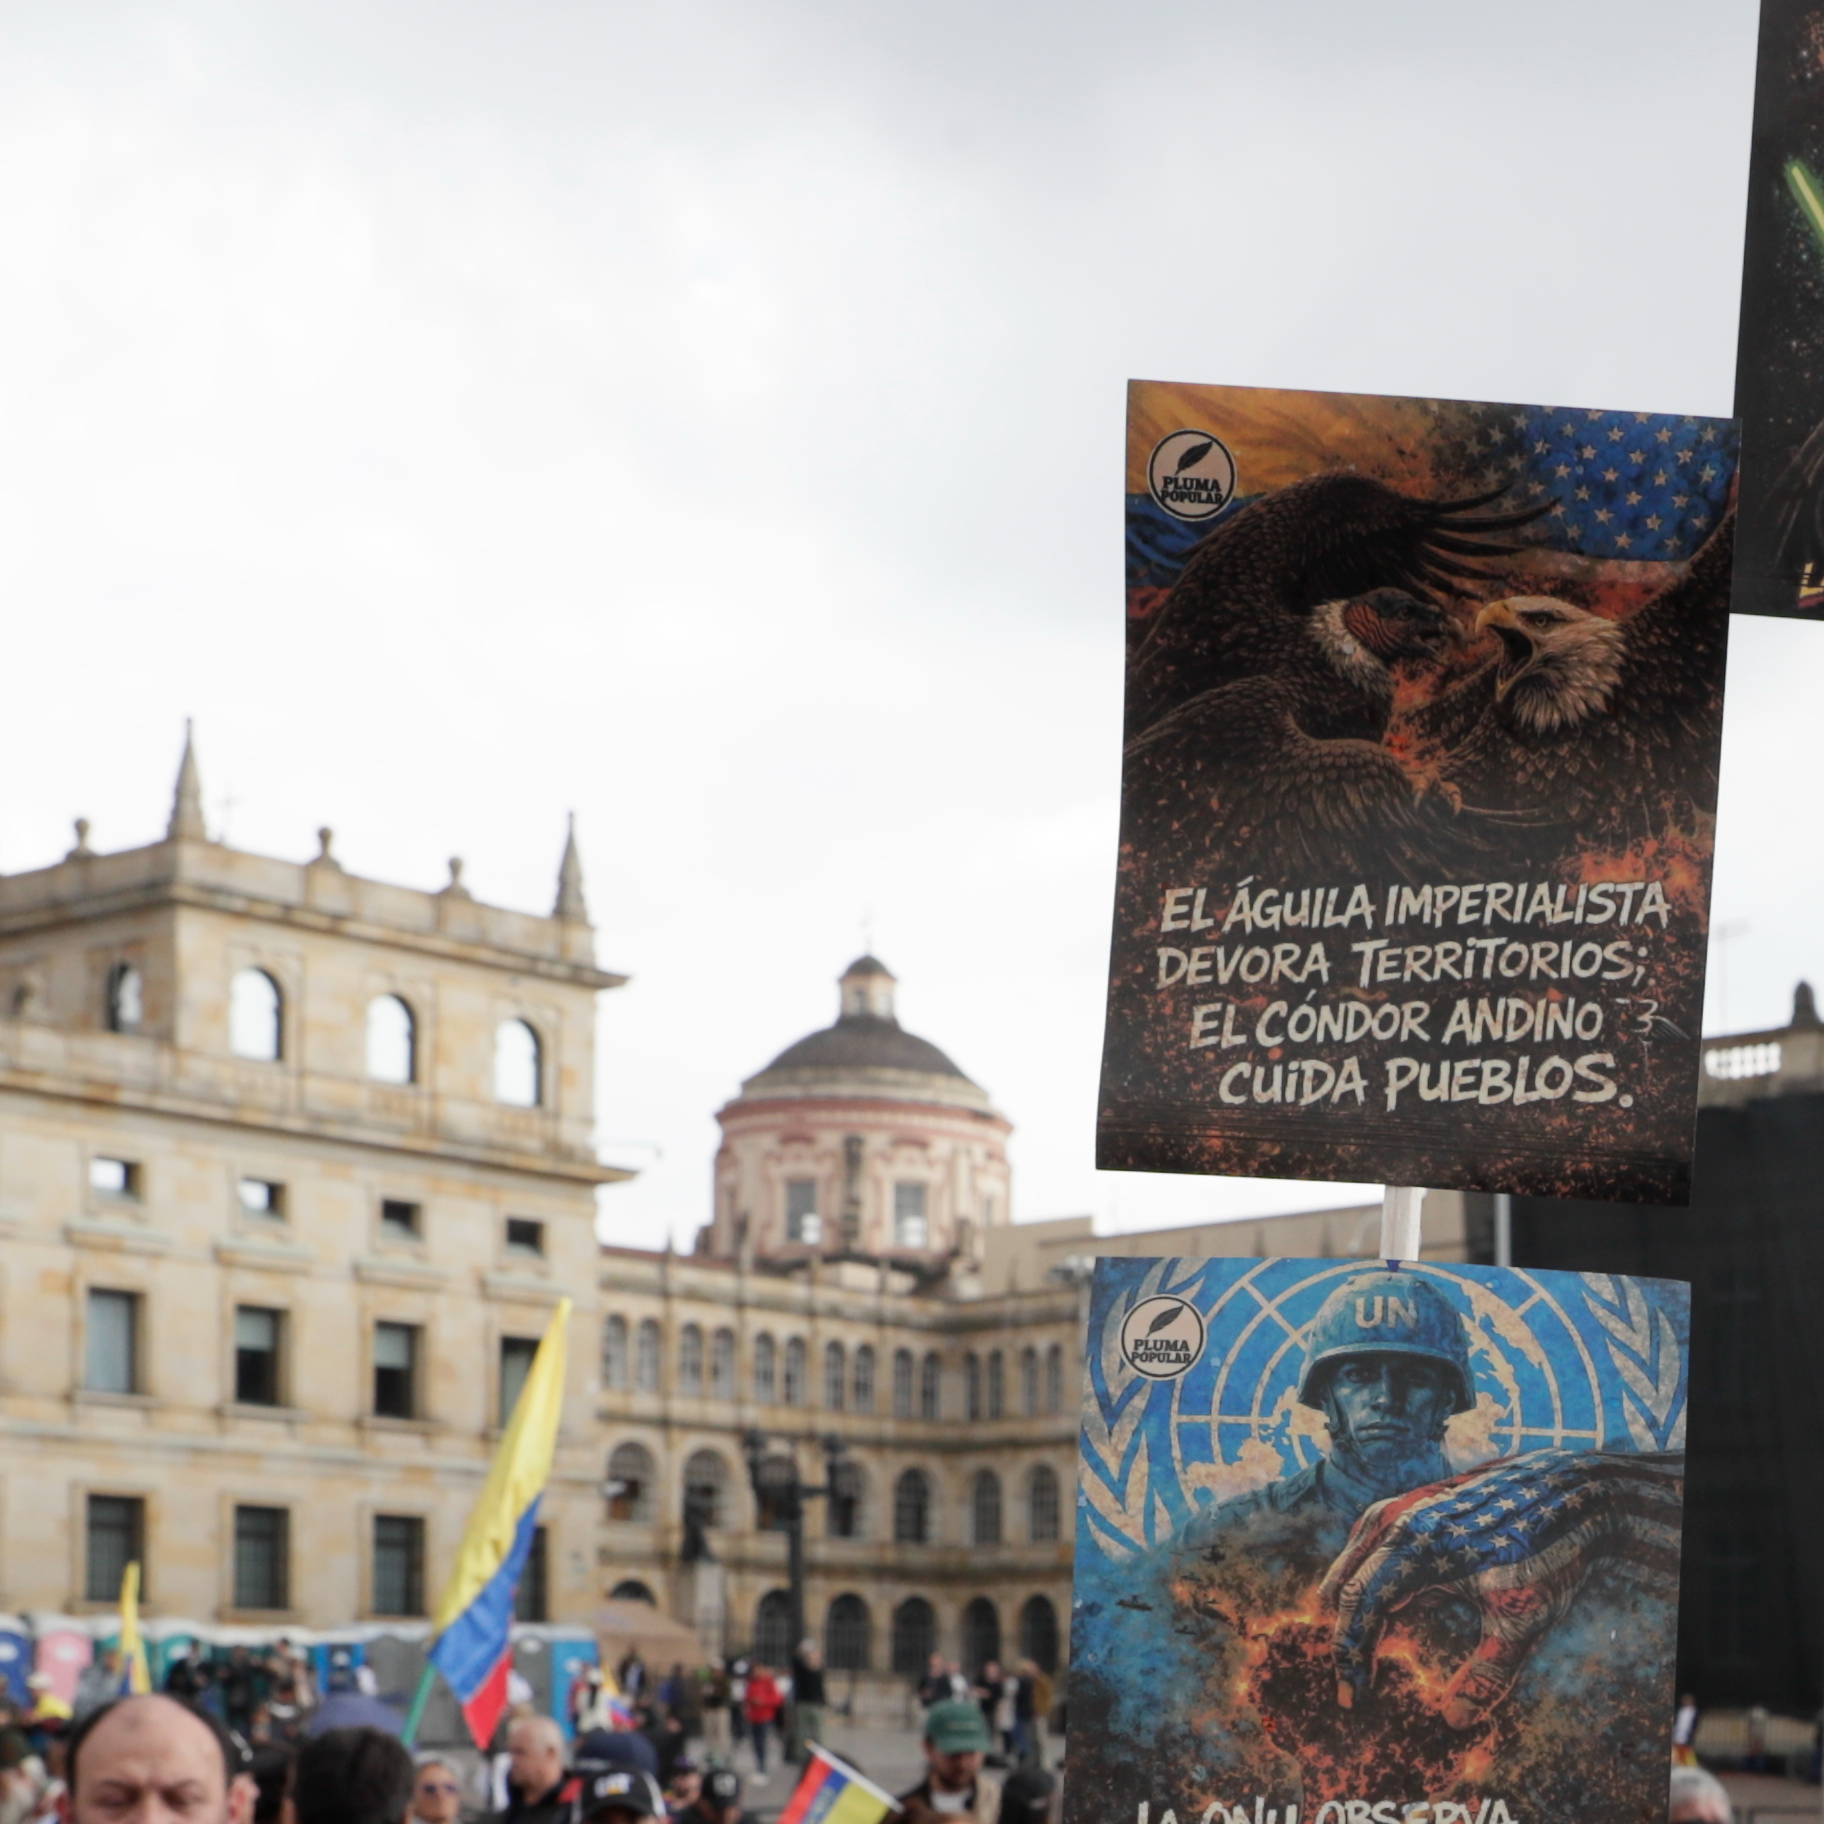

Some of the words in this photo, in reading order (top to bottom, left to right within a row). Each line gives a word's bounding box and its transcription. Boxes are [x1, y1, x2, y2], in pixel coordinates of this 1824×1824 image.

[1160, 489, 1223, 504] POPULAR
[1162, 476, 1222, 492] PLUMA
[1160, 888, 1214, 933] EL
[1222, 875, 1376, 935] ÁGUILA
[1385, 880, 1671, 928] IMPERIALISTA
[1156, 942, 1330, 990] DEVORA
[1189, 1004, 1247, 1050] EL
[1255, 989, 1430, 1047] CÓNDOR
[1442, 997, 1603, 1044] ANDINO
[1385, 1053, 1634, 1112] PUEBLOS.
[1354, 1296, 1419, 1330] UN
[1131, 1351, 1191, 1364] POPULAR
[1133, 1339, 1190, 1352] PLUMA
